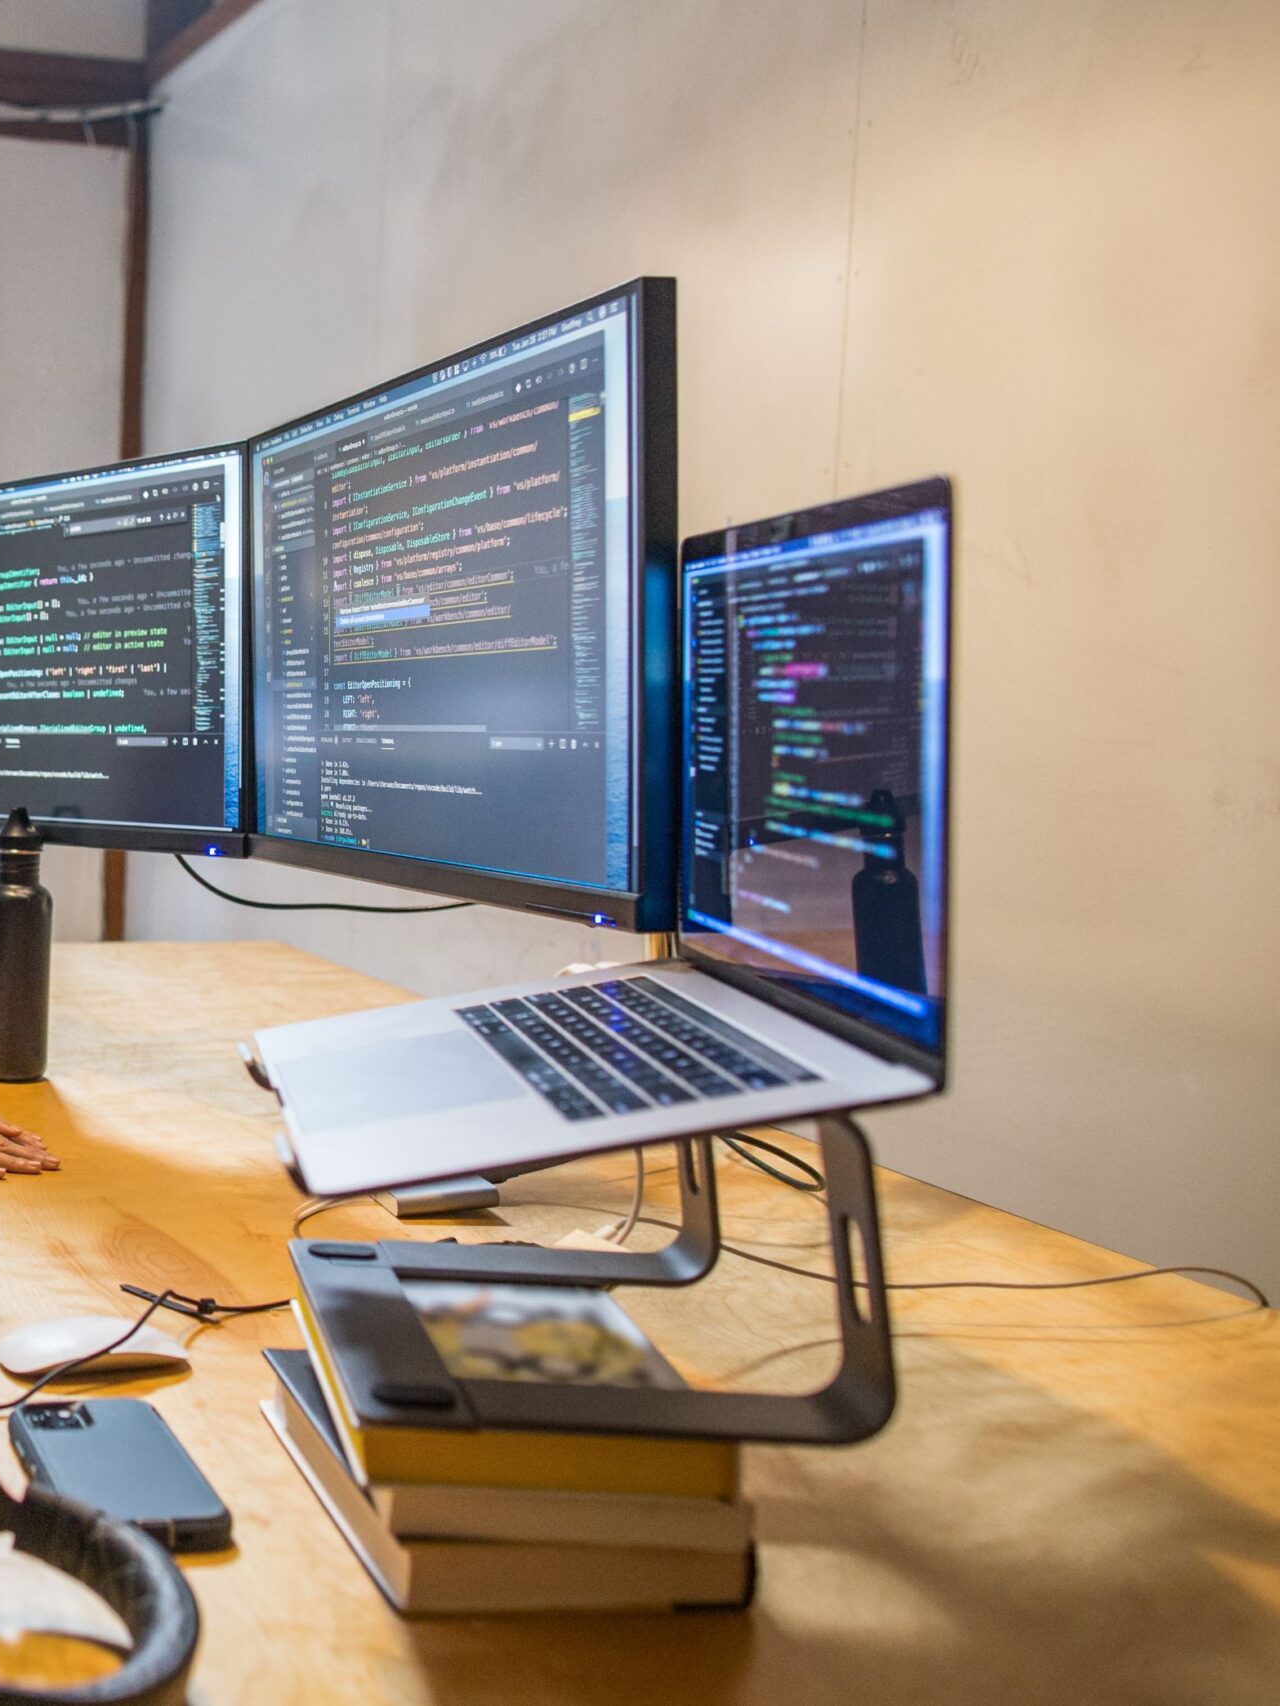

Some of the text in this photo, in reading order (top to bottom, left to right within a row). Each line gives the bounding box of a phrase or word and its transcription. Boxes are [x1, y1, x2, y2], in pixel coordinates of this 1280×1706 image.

[332, 497, 346, 508] import
[415, 474, 427, 484] from
[333, 526, 346, 536] import
[496, 485, 510, 495] from
[333, 554, 347, 564] import
[459, 528, 472, 537] from
[333, 568, 347, 578] import
[353, 564, 374, 575] Registry
[381, 560, 392, 568] from
[381, 574, 392, 583] from
[45, 633, 58, 642] null
[65, 632, 81, 641] null;
[92, 630, 112, 639] editor
[115, 630, 122, 638] in
[124, 628, 148, 638] preview
[150, 628, 167, 636] state
[42, 645, 55, 654] null
[62, 643, 78, 653] null;
[92, 642, 112, 651] editor
[115, 642, 122, 650] in
[124, 640, 144, 649] active
[146, 640, 164, 648] state
[75, 666, 96, 676] 'right'
[105, 664, 127, 673] 'first'
[334, 682, 346, 690] const
[348, 680, 400, 690] EditorOpenPositioning
[62, 690, 85, 698] boolean
[92, 689, 124, 698] undefined;
[343, 695, 355, 704] LEFT:
[358, 694, 374, 705] 'left',
[343, 710, 357, 718] RIGHT:
[360, 709, 379, 719] 'right',
[114, 724, 146, 734] undefined,
